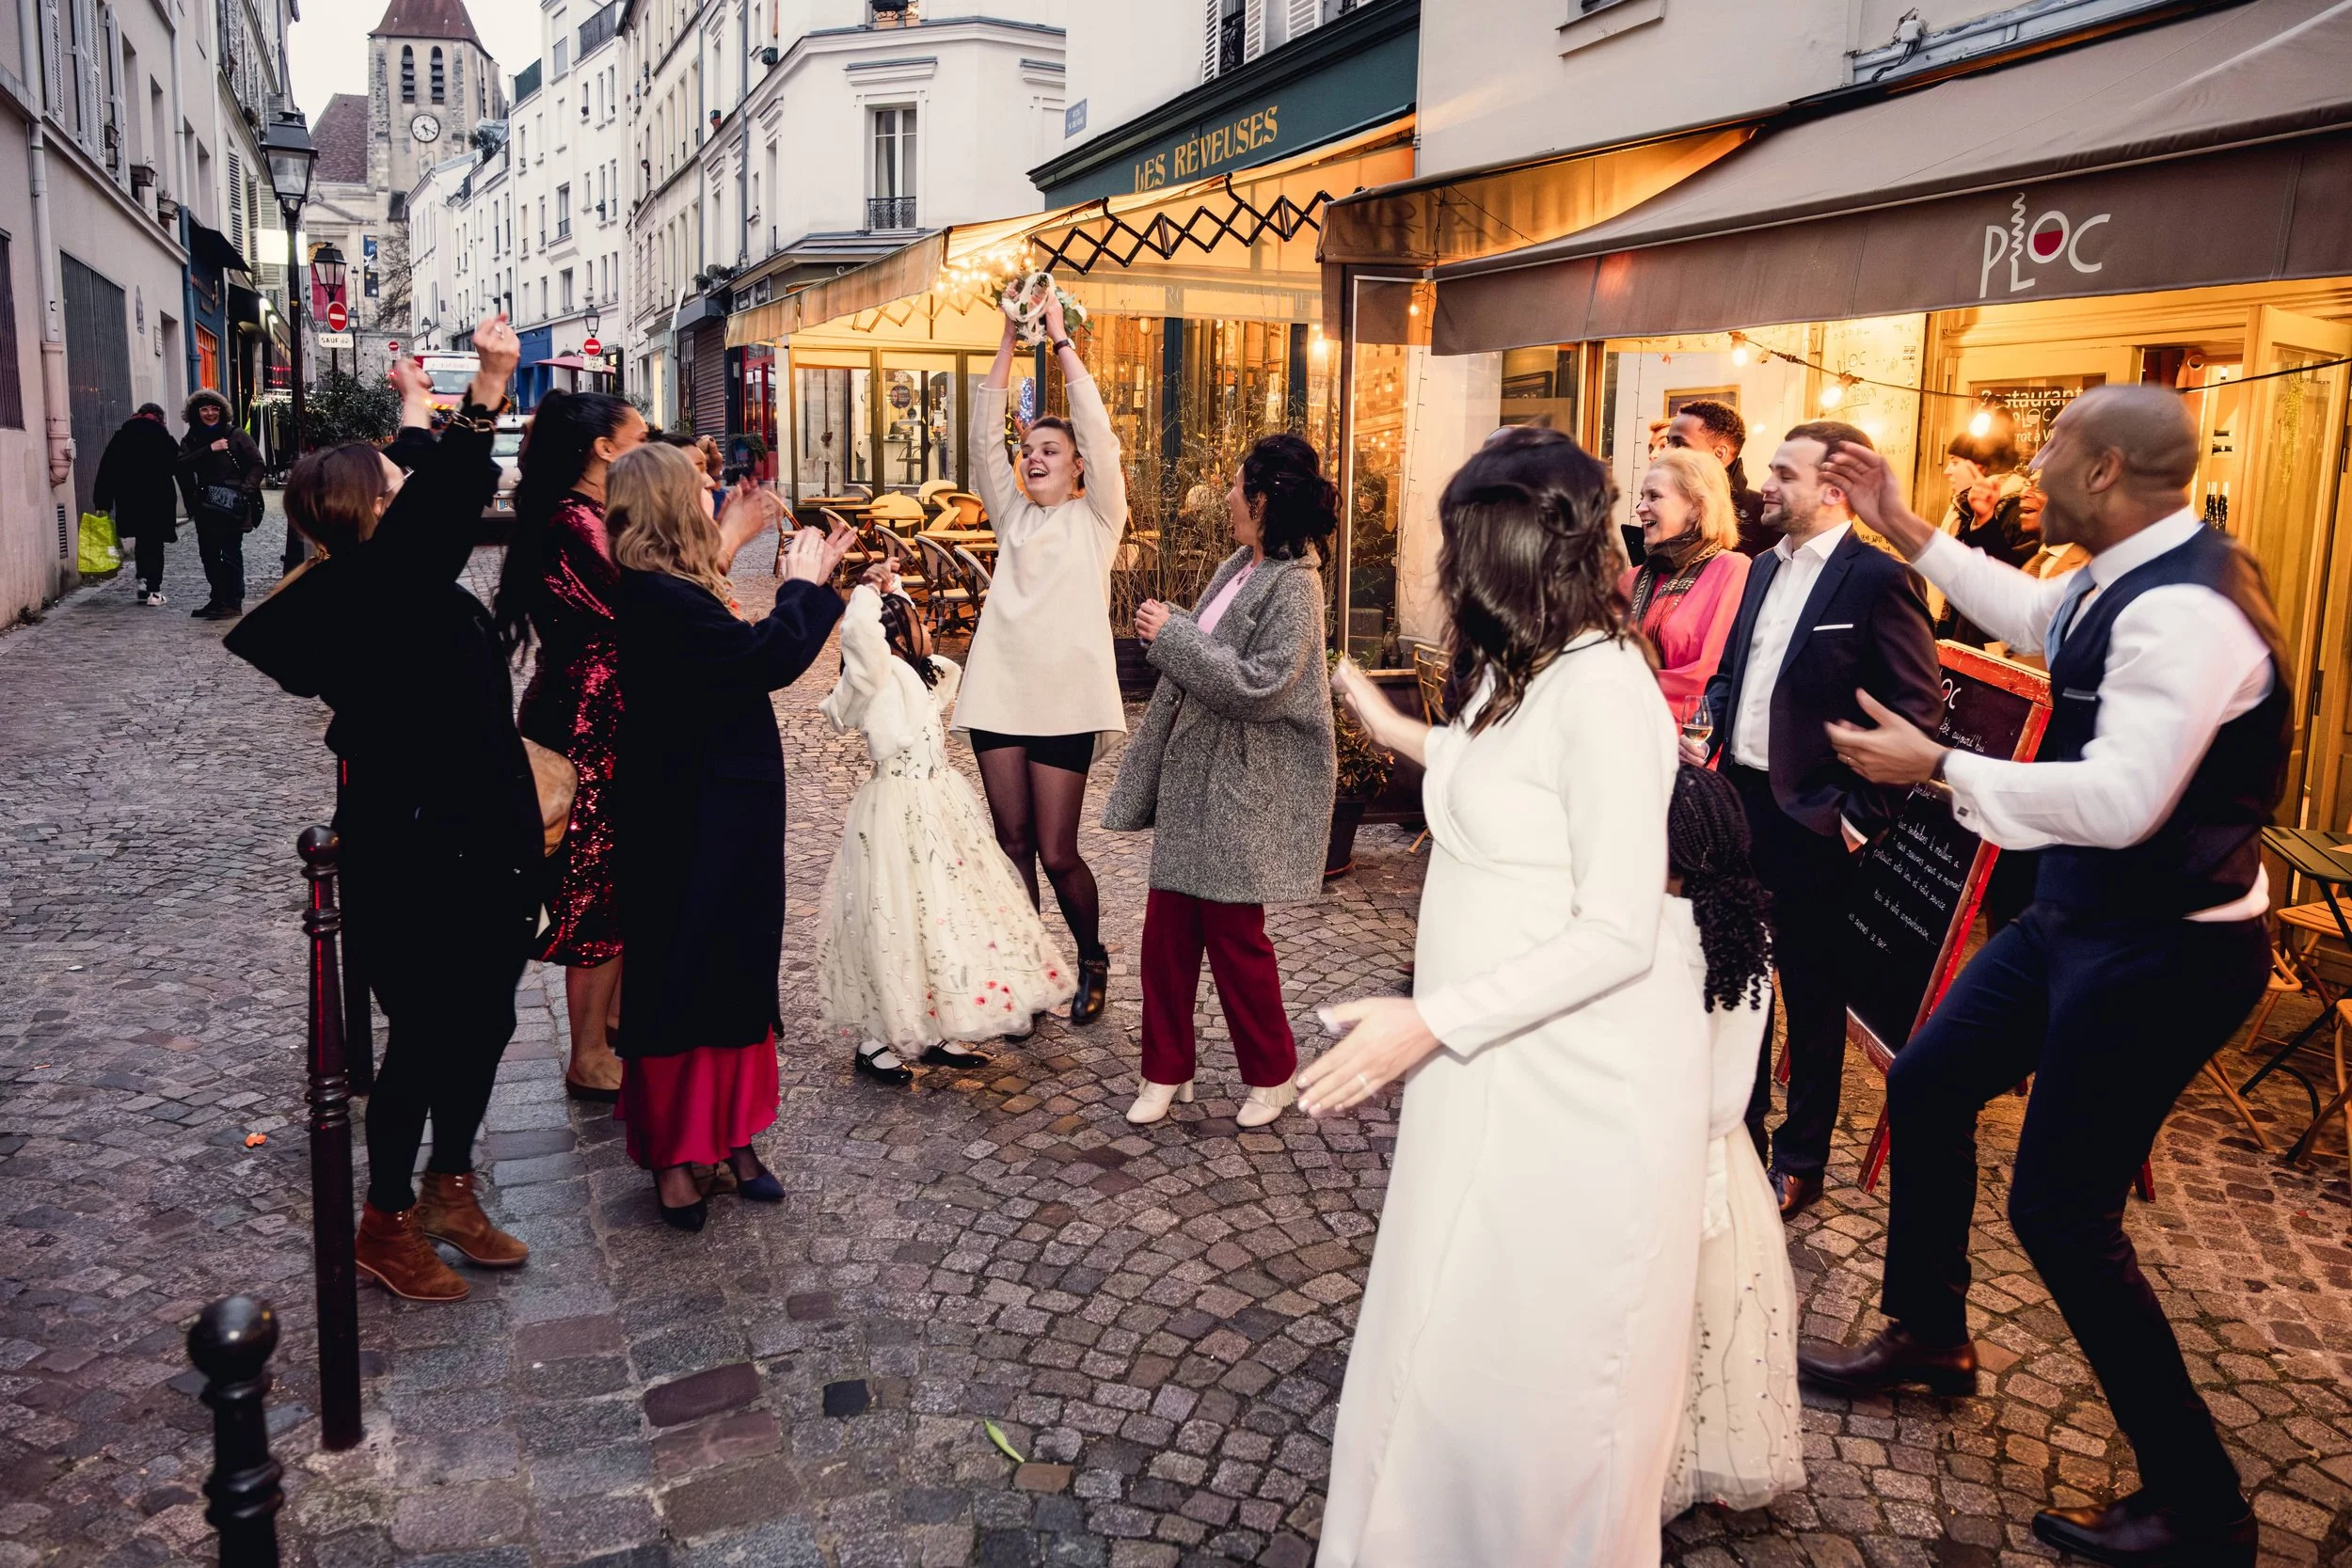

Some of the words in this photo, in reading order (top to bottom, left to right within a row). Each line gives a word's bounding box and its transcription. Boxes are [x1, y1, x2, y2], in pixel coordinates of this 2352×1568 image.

[1135, 152, 1166, 194] LES
[1174, 105, 1279, 179] RÊVEUSES
[1979, 192, 2111, 298] PLOC
[1981, 386, 2083, 408] Rstaurant
[1941, 678, 1961, 709] OC
[1952, 729, 1984, 752] aujourd'hui
[1943, 877, 1963, 891] moment
